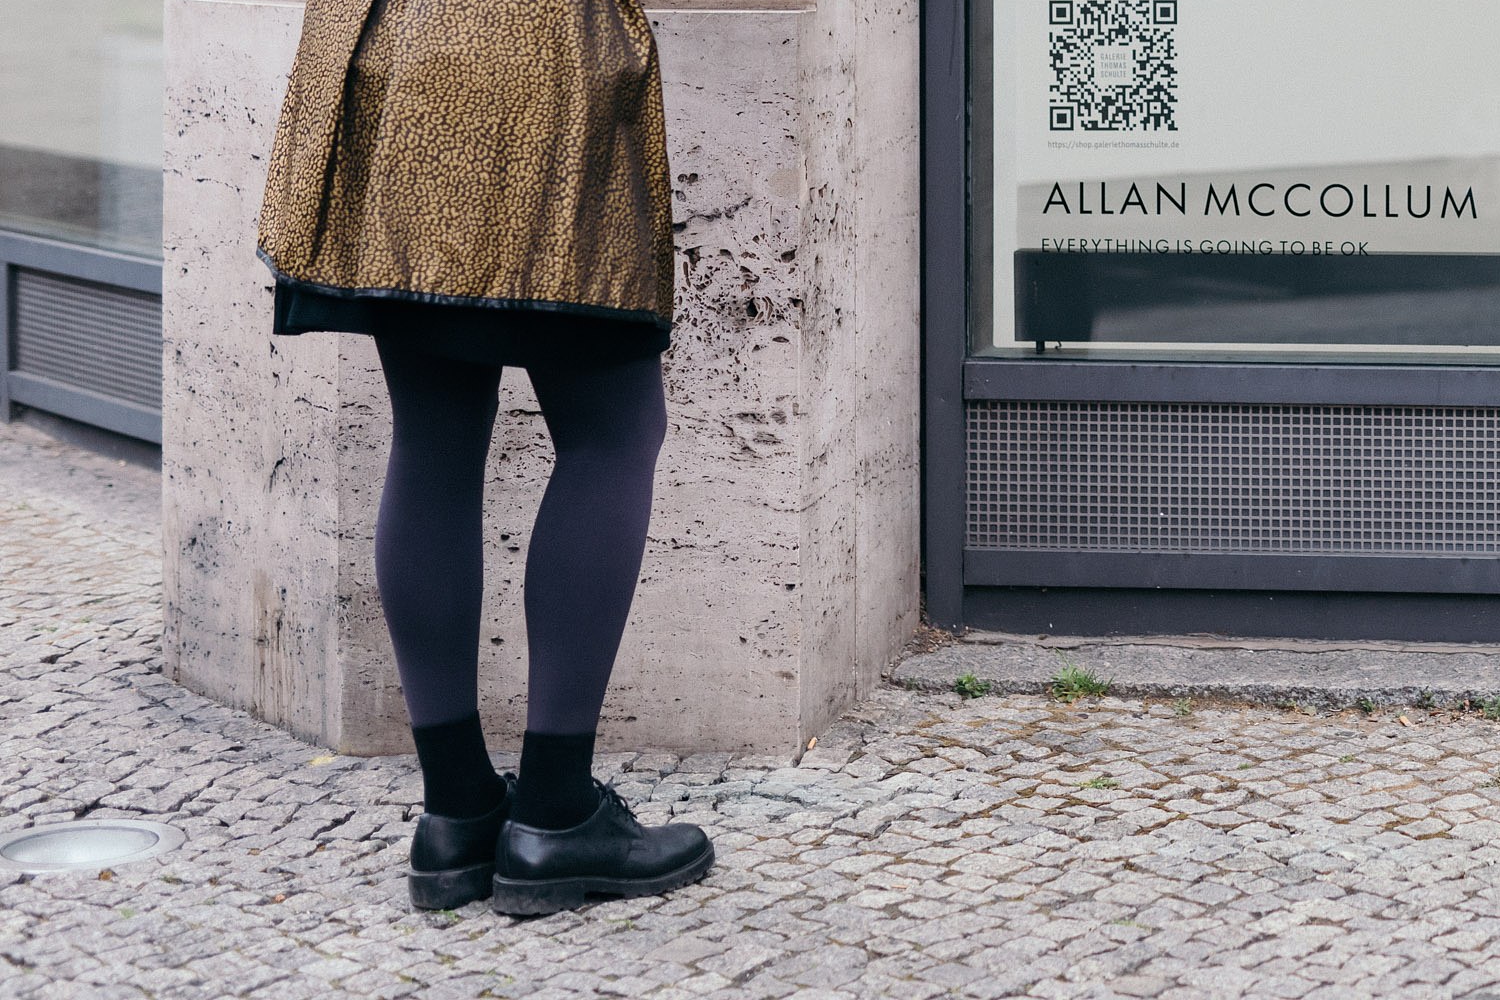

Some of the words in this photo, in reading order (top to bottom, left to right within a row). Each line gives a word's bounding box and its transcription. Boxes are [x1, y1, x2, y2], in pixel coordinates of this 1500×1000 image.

[1047, 140, 1181, 150] https://shop.galeriethomasschulte.de
[1043, 182, 1186, 215] ALLAN
[1204, 183, 1478, 219] MCCOLLUM
[1041, 238, 1170, 255] EVERYTHING
[1176, 239, 1193, 255] IS
[1200, 239, 1273, 256] GOING
[1280, 240, 1306, 256] TO
[1312, 241, 1334, 256] BE
[1340, 241, 1370, 256] OK
